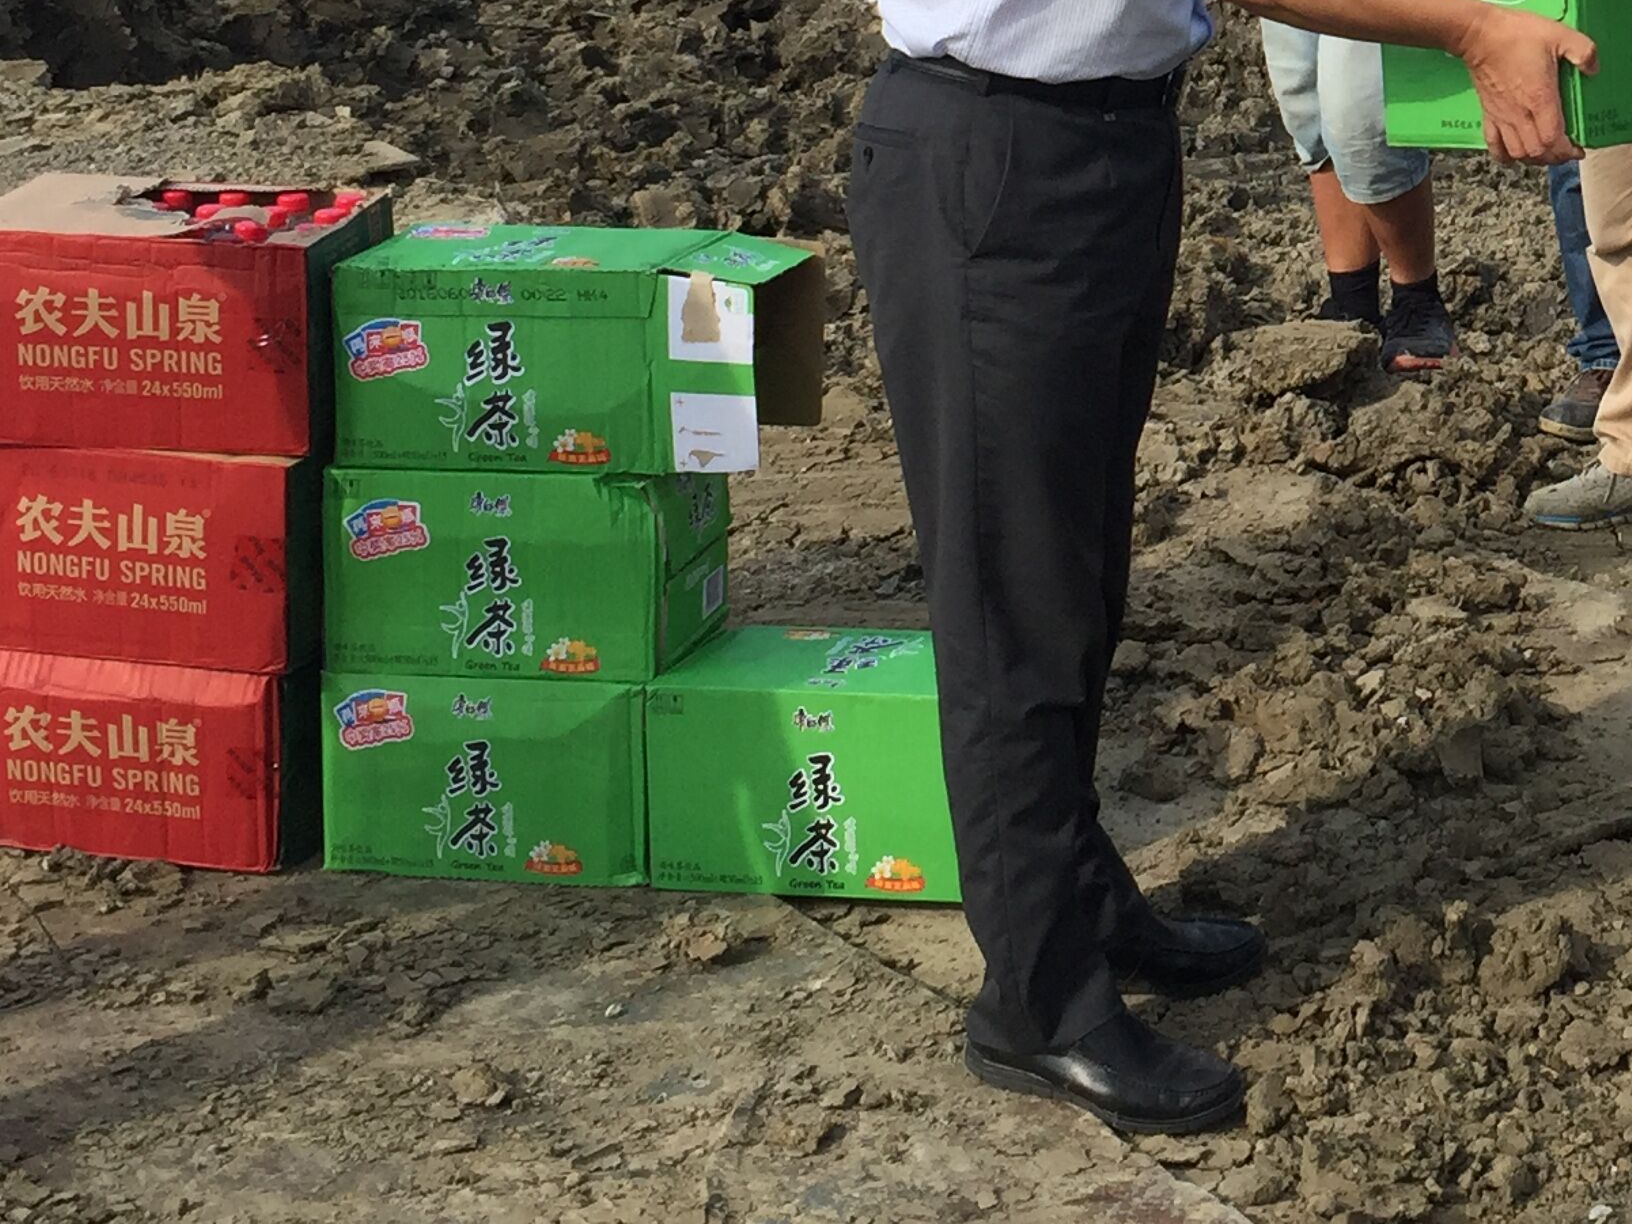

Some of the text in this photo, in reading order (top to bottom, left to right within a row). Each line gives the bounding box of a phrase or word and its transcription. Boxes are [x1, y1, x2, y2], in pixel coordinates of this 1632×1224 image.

[14, 285, 224, 345] 农夫山泉
[17, 343, 223, 375] NONGFU SPRING
[141, 380, 224, 400] 24x550ml
[465, 321, 524, 452] 绿茶
[15, 494, 208, 560] 农夫山泉
[16, 550, 207, 591] NONGFU SPRING
[130, 592, 207, 615] 24x550ml
[464, 536, 521, 657] 绿茶
[465, 659, 520, 672] Green Tea
[3, 705, 200, 767] 农夫山泉
[6, 758, 200, 796] NONGFU SPRING
[124, 798, 200, 820] 24x550ml
[445, 739, 502, 859] 绿茶
[786, 752, 845, 875] 绿茶
[788, 877, 845, 890] Green Tea
